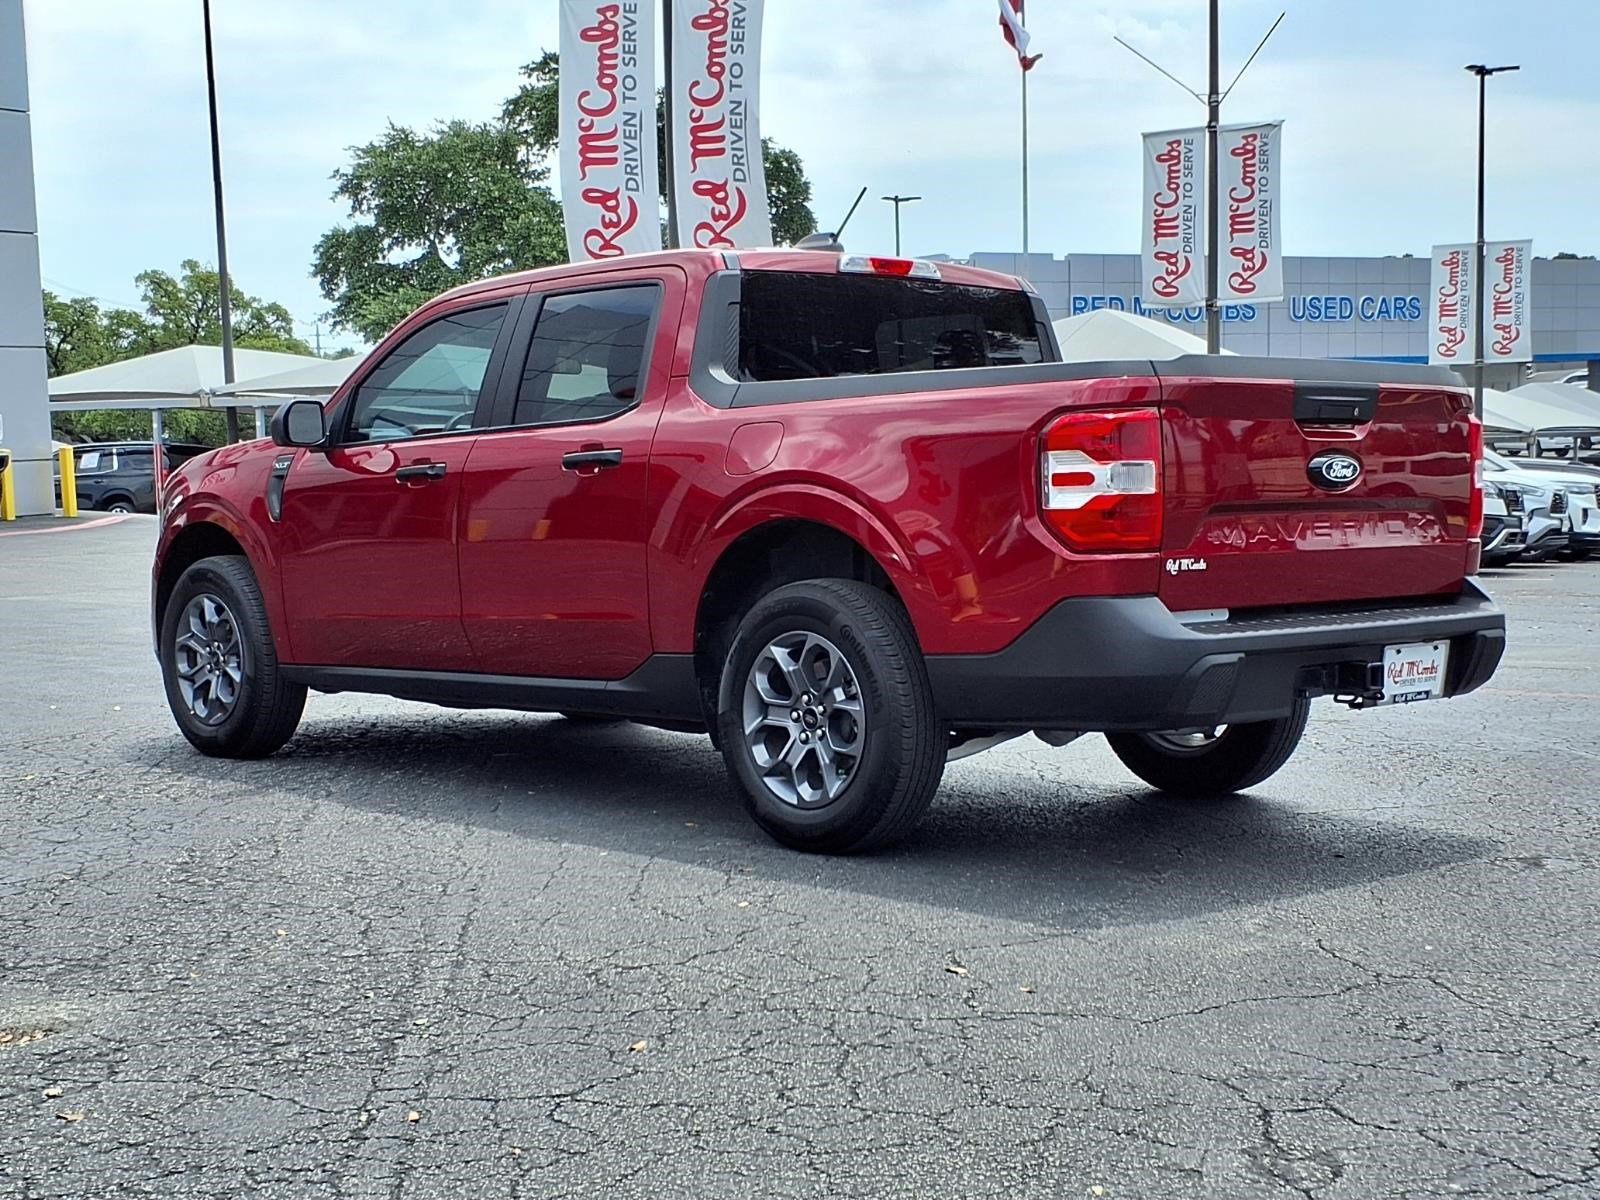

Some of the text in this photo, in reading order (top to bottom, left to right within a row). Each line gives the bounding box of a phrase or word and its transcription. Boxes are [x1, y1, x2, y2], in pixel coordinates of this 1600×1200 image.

[578, 4, 638, 259] Red McCombs
[622, 2, 640, 193] DRIVEN TO SERVE
[730, 0, 748, 183] DRIVEN TO SERV
[693, 178, 746, 249] Red
[1152, 139, 1191, 298] Red McCombs
[1182, 138, 1194, 253] DRIVEN TO SERVE
[1228, 133, 1267, 294] Red McCombs
[1258, 132, 1269, 249] DRIVEN TO SERVE
[1072, 296, 1125, 316] RED
[1291, 296, 1353, 321] USED
[1360, 296, 1421, 321] CARS
[1437, 250, 1465, 357] Red McCombs
[1459, 250, 1469, 328] DRIVEN TO SERVE
[1492, 247, 1520, 355] Red McCombs
[1514, 247, 1523, 326] DRIVEN TO SERVE
[1208, 513, 1440, 547] MAVERICK
[1387, 661, 1404, 685] Red
